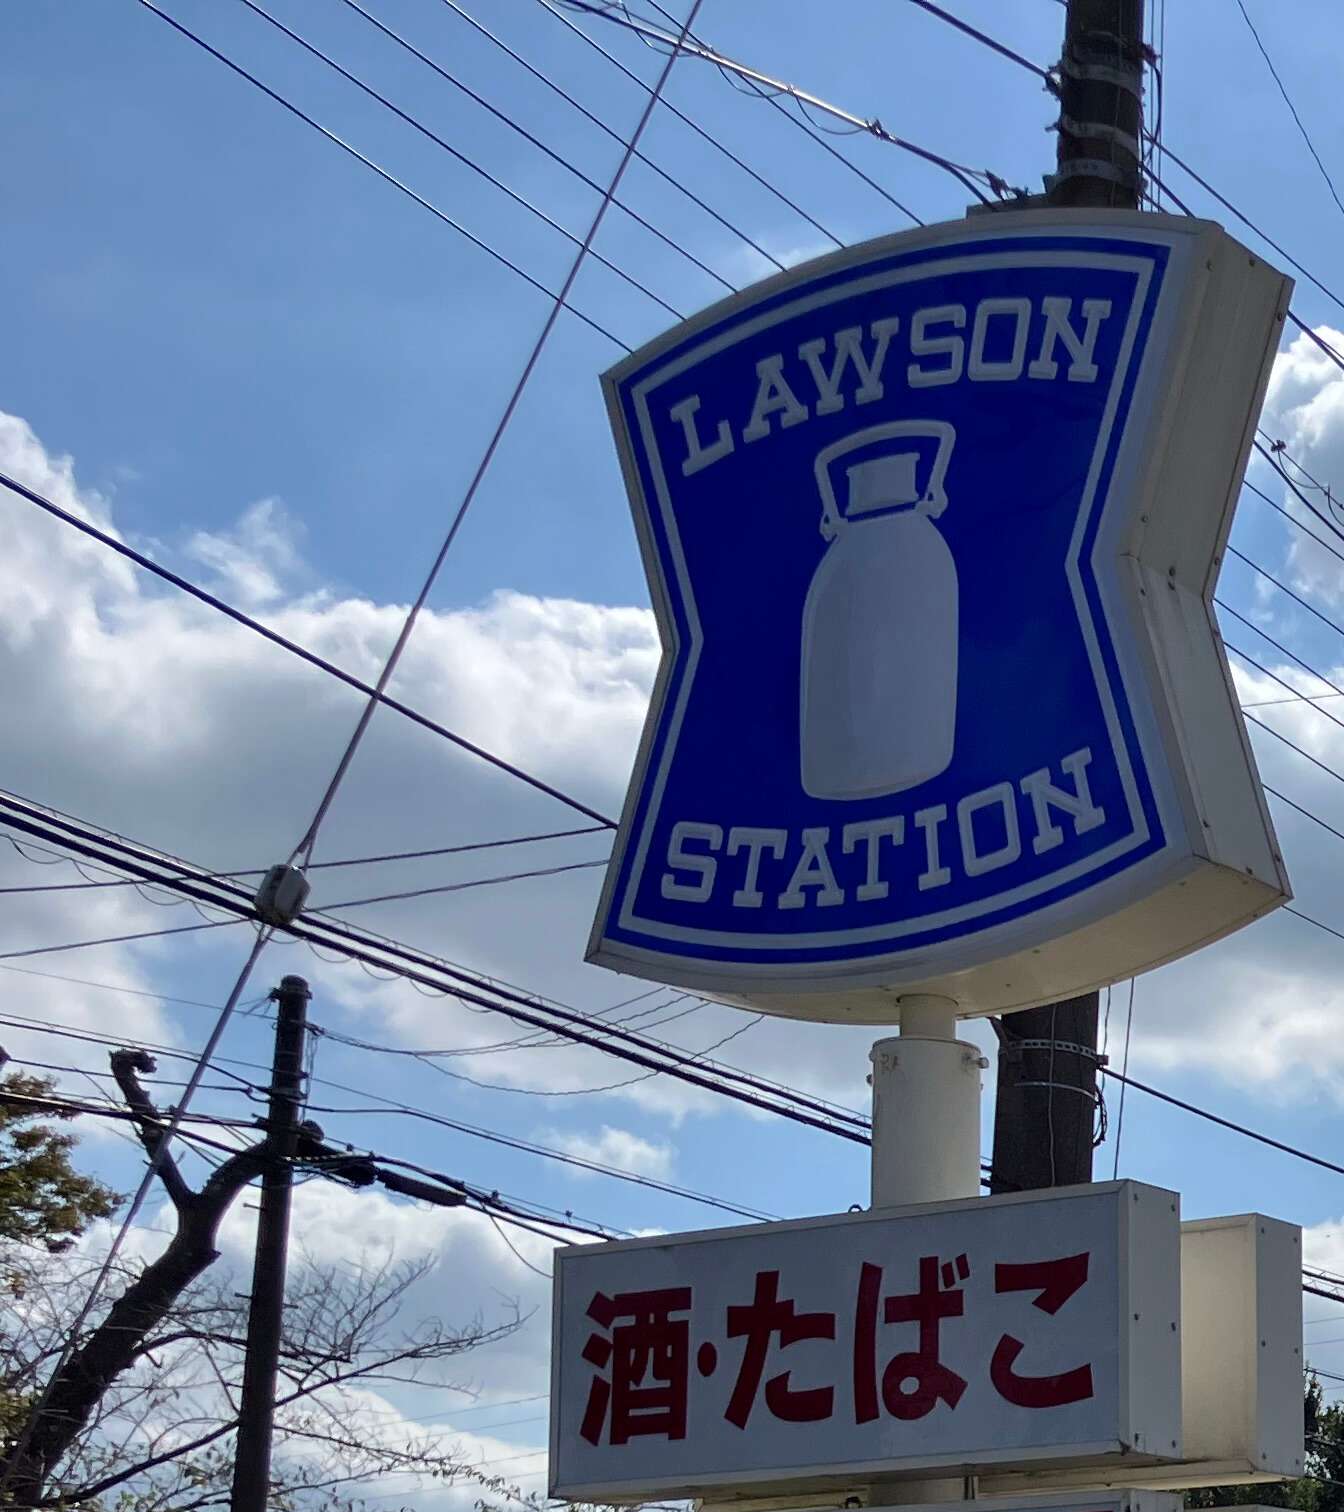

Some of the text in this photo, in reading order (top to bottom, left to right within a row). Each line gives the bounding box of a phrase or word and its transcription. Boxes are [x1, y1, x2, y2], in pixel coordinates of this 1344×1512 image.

[670, 297, 1112, 477] LAWSON
[661, 748, 1106, 909] STATION
[579, 1252, 1094, 1447] 酒・たばこ
